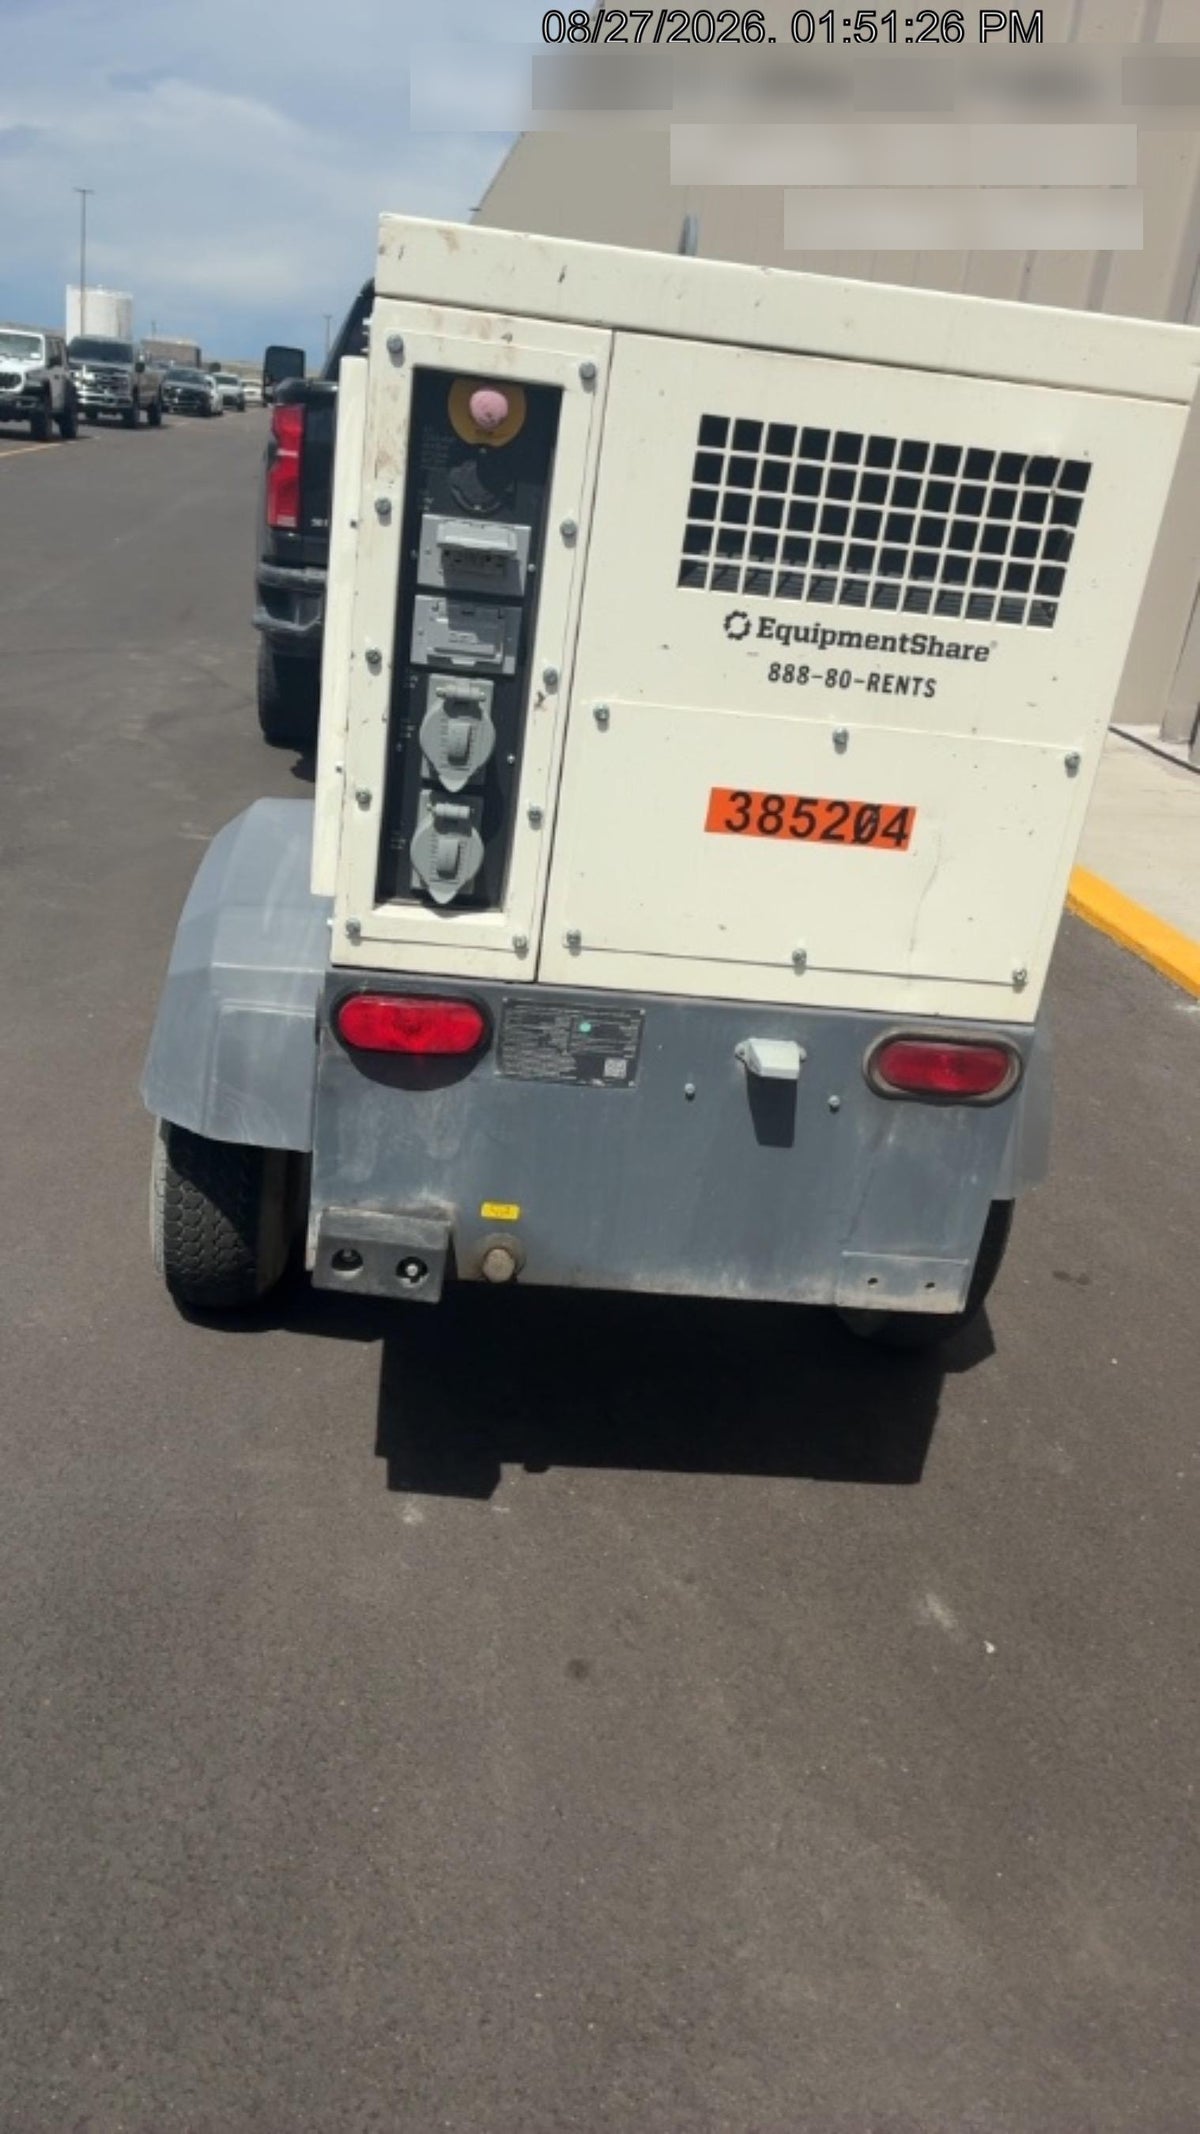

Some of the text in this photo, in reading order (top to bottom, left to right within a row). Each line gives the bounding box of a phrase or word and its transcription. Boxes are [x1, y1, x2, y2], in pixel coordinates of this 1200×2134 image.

[756, 616, 990, 662] EquipmentShare
[768, 662, 937, 698] 888-80-RENTS
[725, 791, 910, 847] 385204
